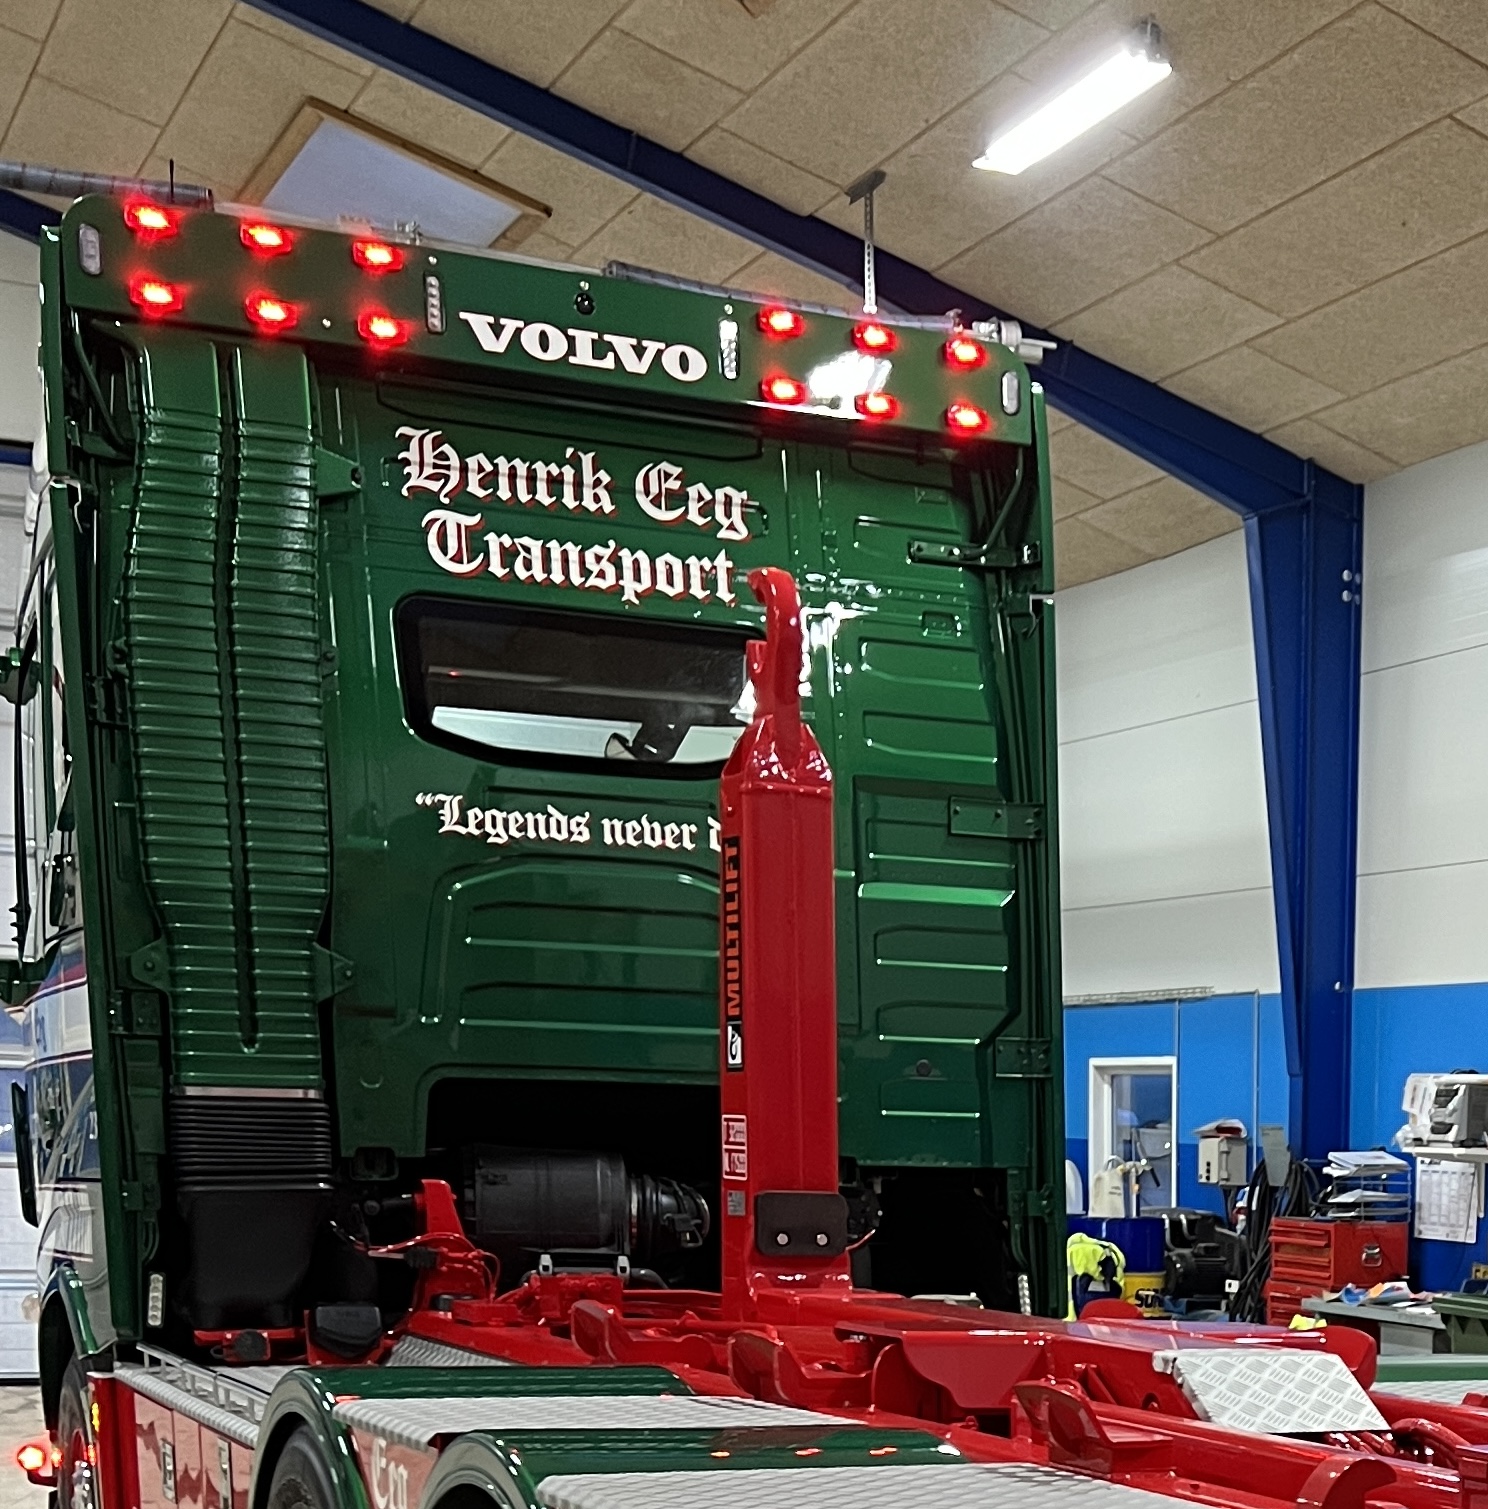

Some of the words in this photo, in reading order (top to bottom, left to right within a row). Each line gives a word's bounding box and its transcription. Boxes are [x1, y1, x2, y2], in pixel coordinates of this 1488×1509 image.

[458, 311, 708, 382] VOLVO
[395, 426, 618, 516] Henrik
[634, 461, 750, 542] Eeg
[421, 509, 738, 606] Transport
[601, 814, 698, 852] never
[725, 843, 741, 1016] MULTILIFT
